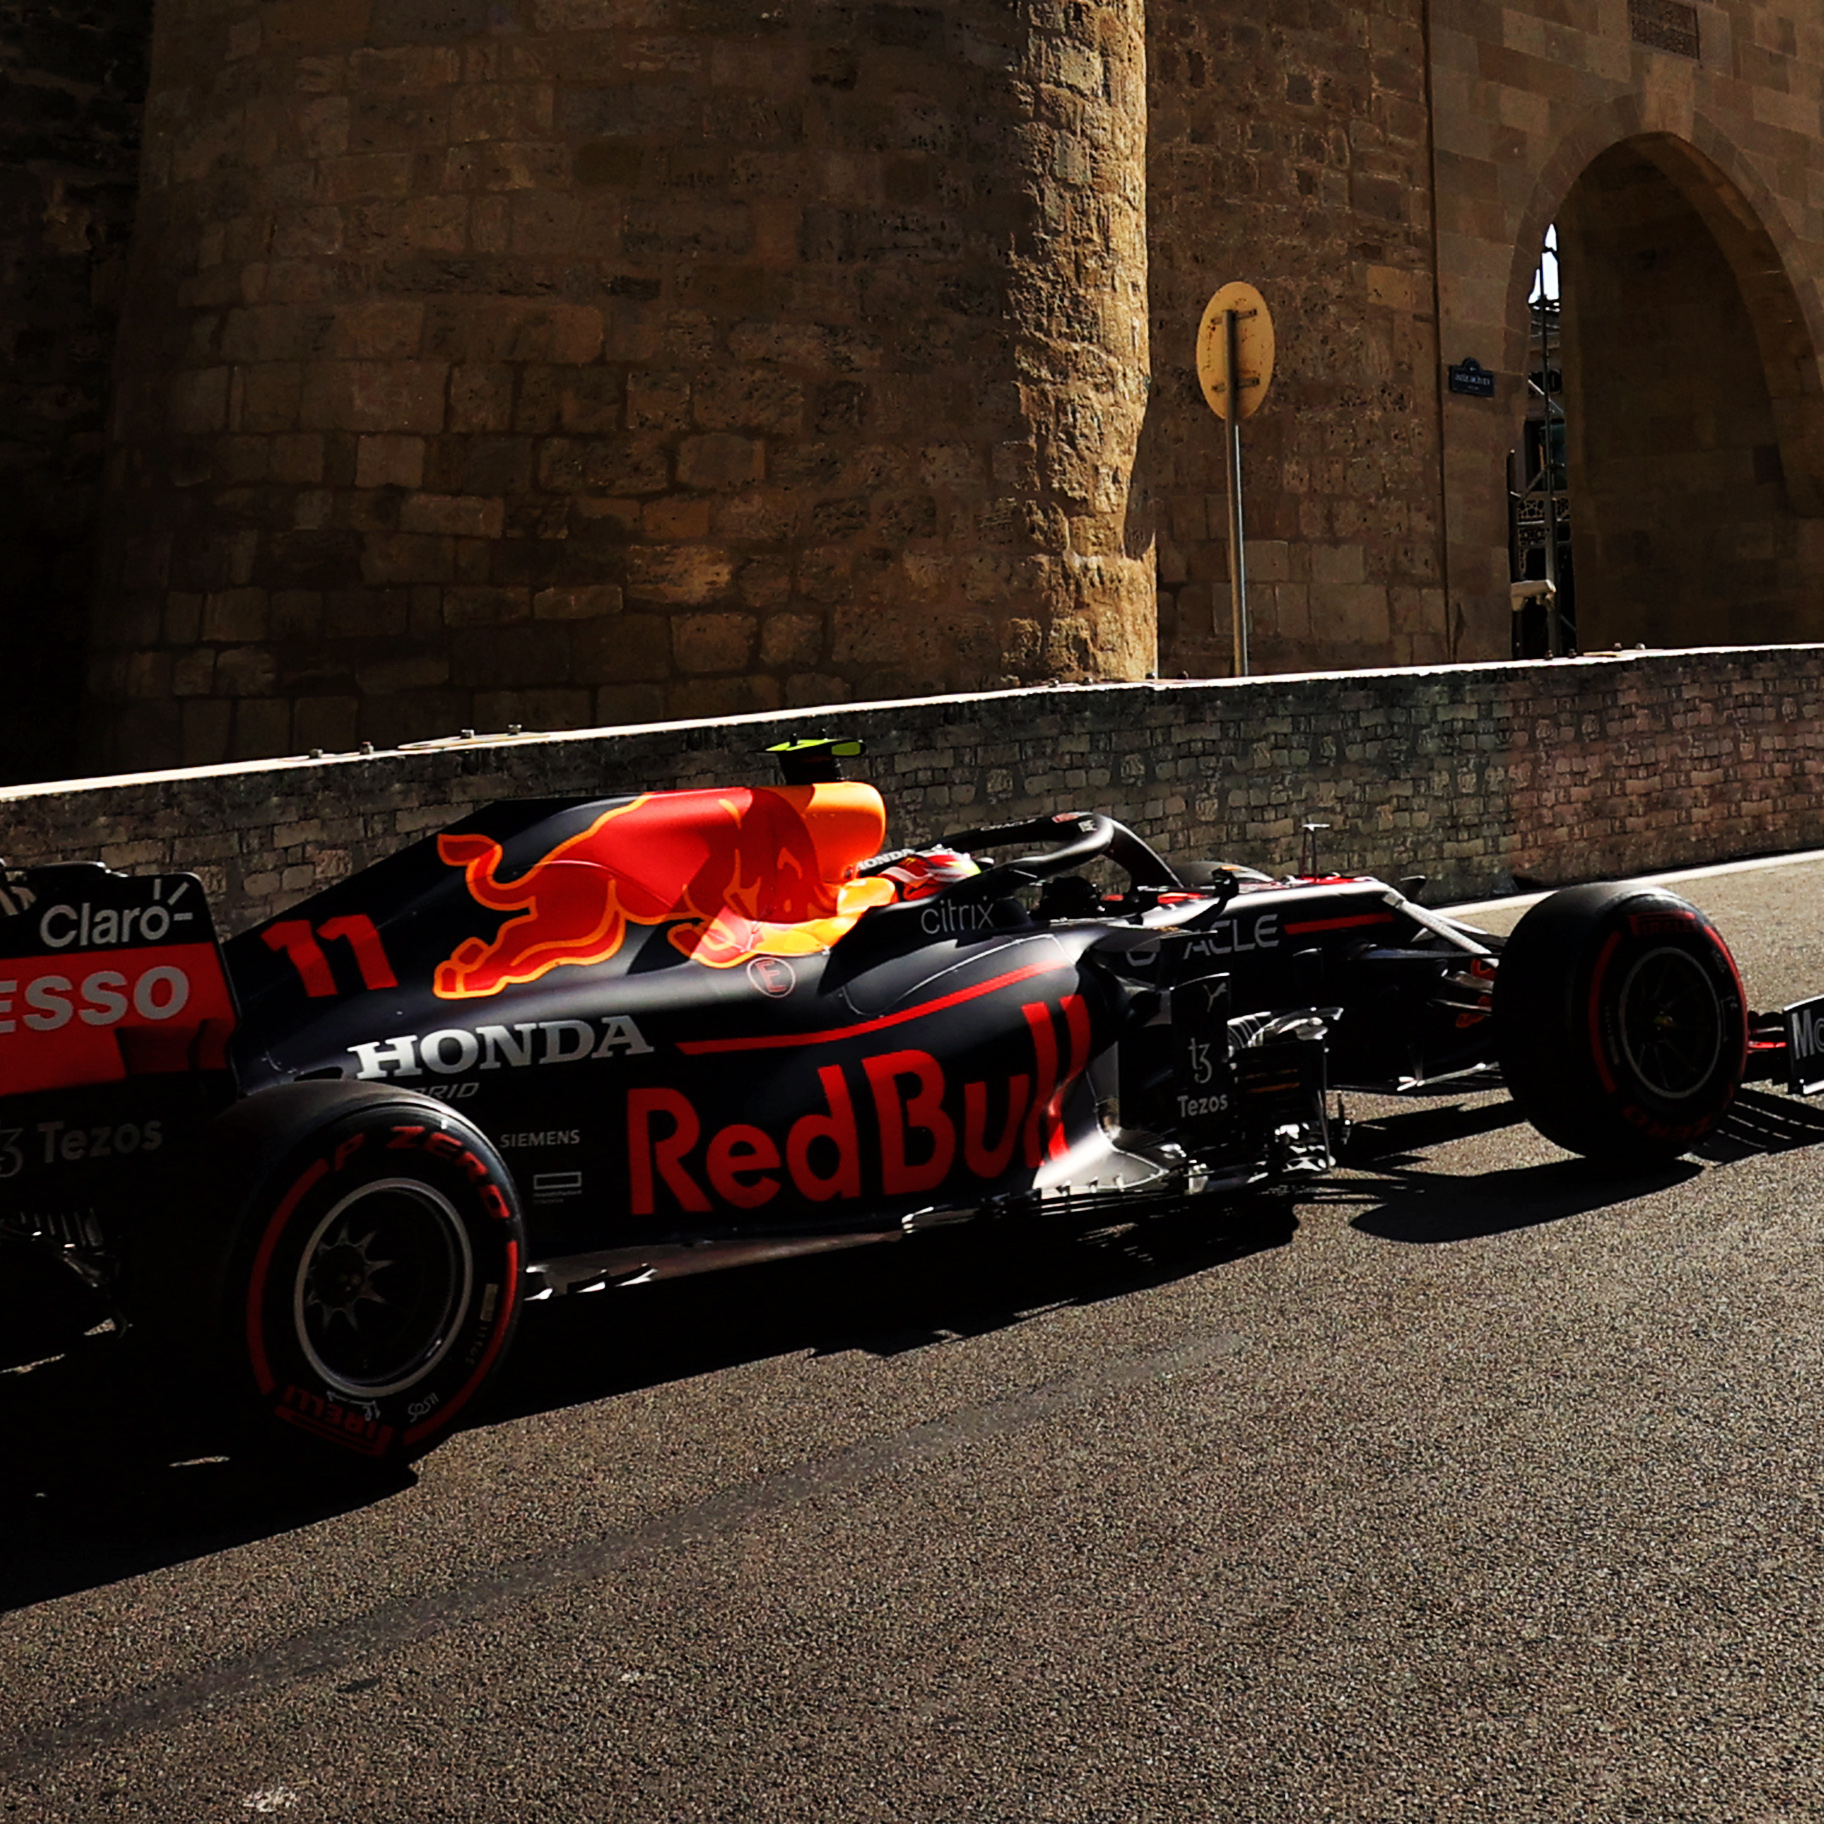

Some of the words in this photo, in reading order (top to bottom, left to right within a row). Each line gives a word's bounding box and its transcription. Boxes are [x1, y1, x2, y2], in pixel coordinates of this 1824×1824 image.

[39, 902, 171, 948] Claro
[920, 894, 995, 935] citrix
[261, 913, 398, 998] 11
[1125, 913, 1281, 967] ACLE
[755, 959, 787, 992] E
[346, 1014, 656, 1080] HONDA
[625, 1064, 863, 1217] Red
[861, 994, 1093, 1197] Bull
[1177, 1094, 1229, 1119] Tezos
[37, 1120, 164, 1163] Tezos
[499, 1129, 581, 1149] SIEMENS
[384, 1126, 511, 1220] ZERO
[275, 1385, 394, 1458] PIRELLI
